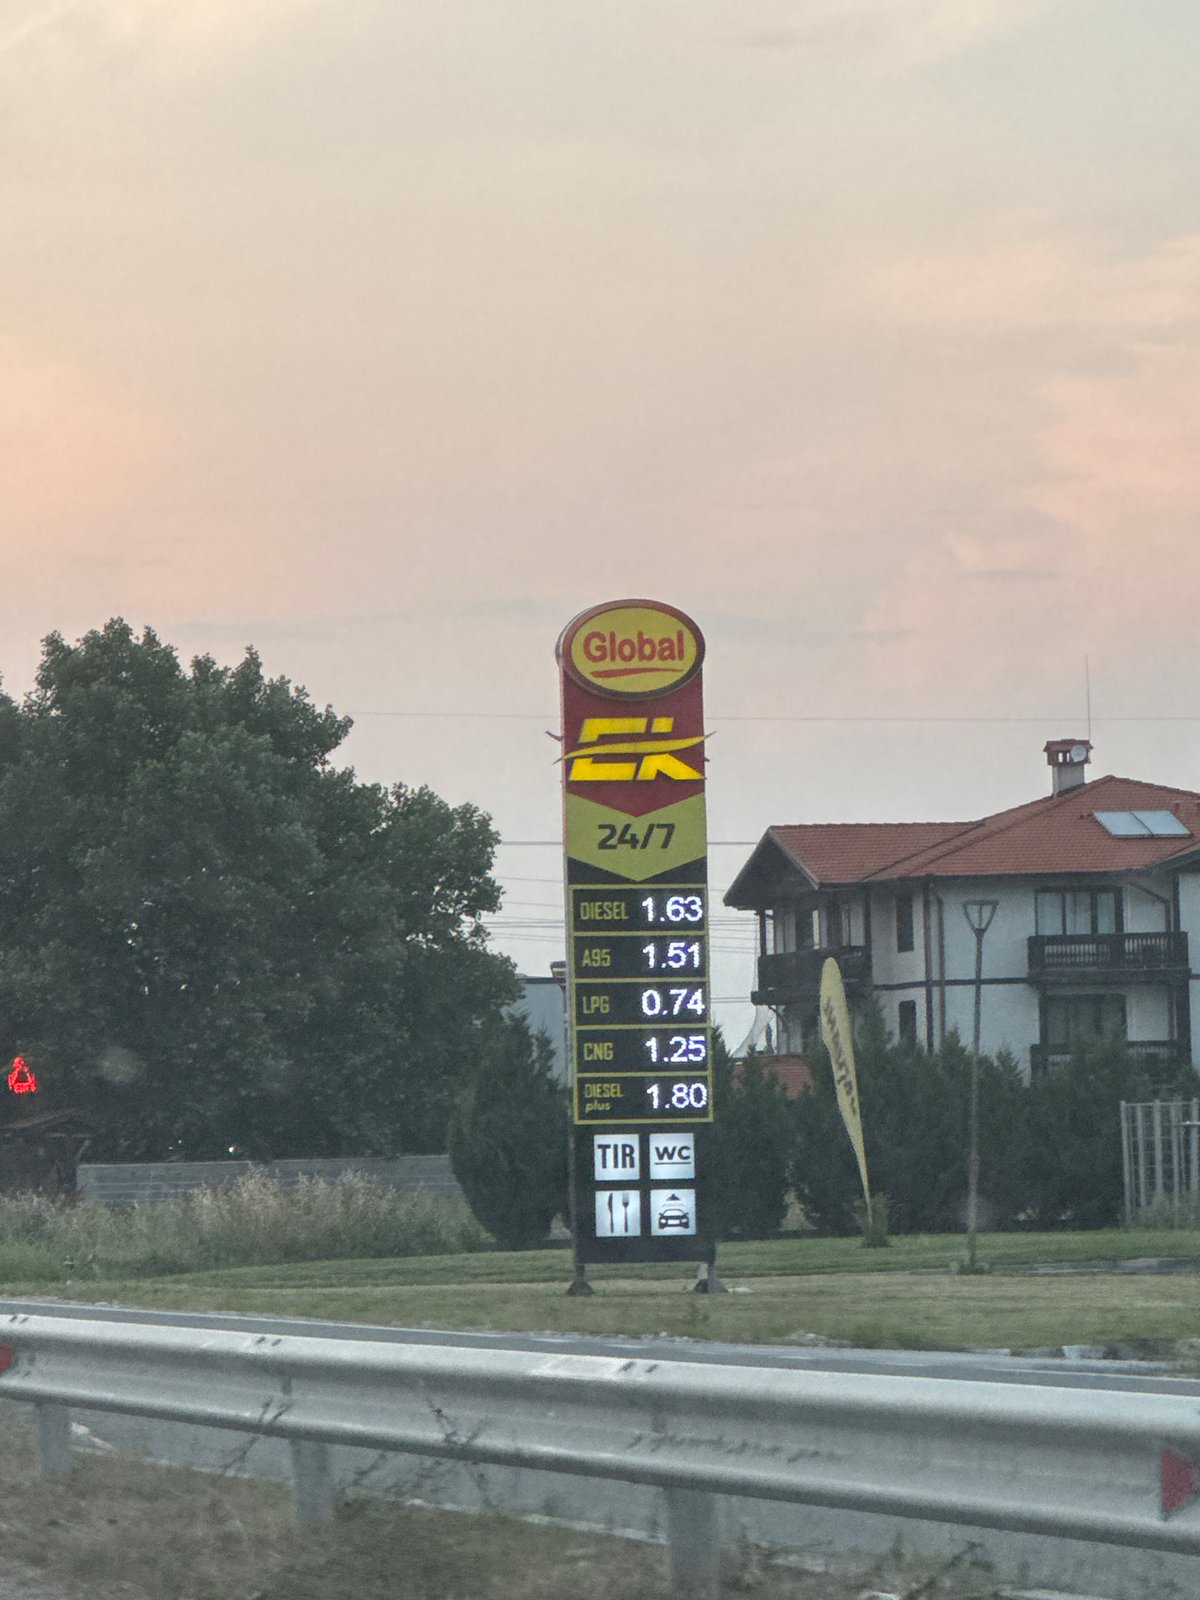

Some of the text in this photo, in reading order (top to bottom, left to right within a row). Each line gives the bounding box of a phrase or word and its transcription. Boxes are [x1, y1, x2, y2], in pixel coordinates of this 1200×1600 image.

[583, 630, 684, 662] Global
[597, 823, 676, 850] 24/7
[580, 902, 629, 920] DIESEL
[642, 896, 703, 922] 1.63
[582, 949, 611, 967] A95
[642, 942, 699, 968] 1.51
[583, 996, 610, 1013] LPG
[641, 989, 705, 1016] 0.74
[583, 1043, 613, 1060] CNG
[645, 1036, 706, 1062] 1.25
[584, 1083, 623, 1098] DIESEL
[647, 1083, 708, 1109] 1.80
[586, 1098, 611, 1112] plus
[597, 1144, 635, 1169] TIR
[655, 1146, 691, 1160] WC
